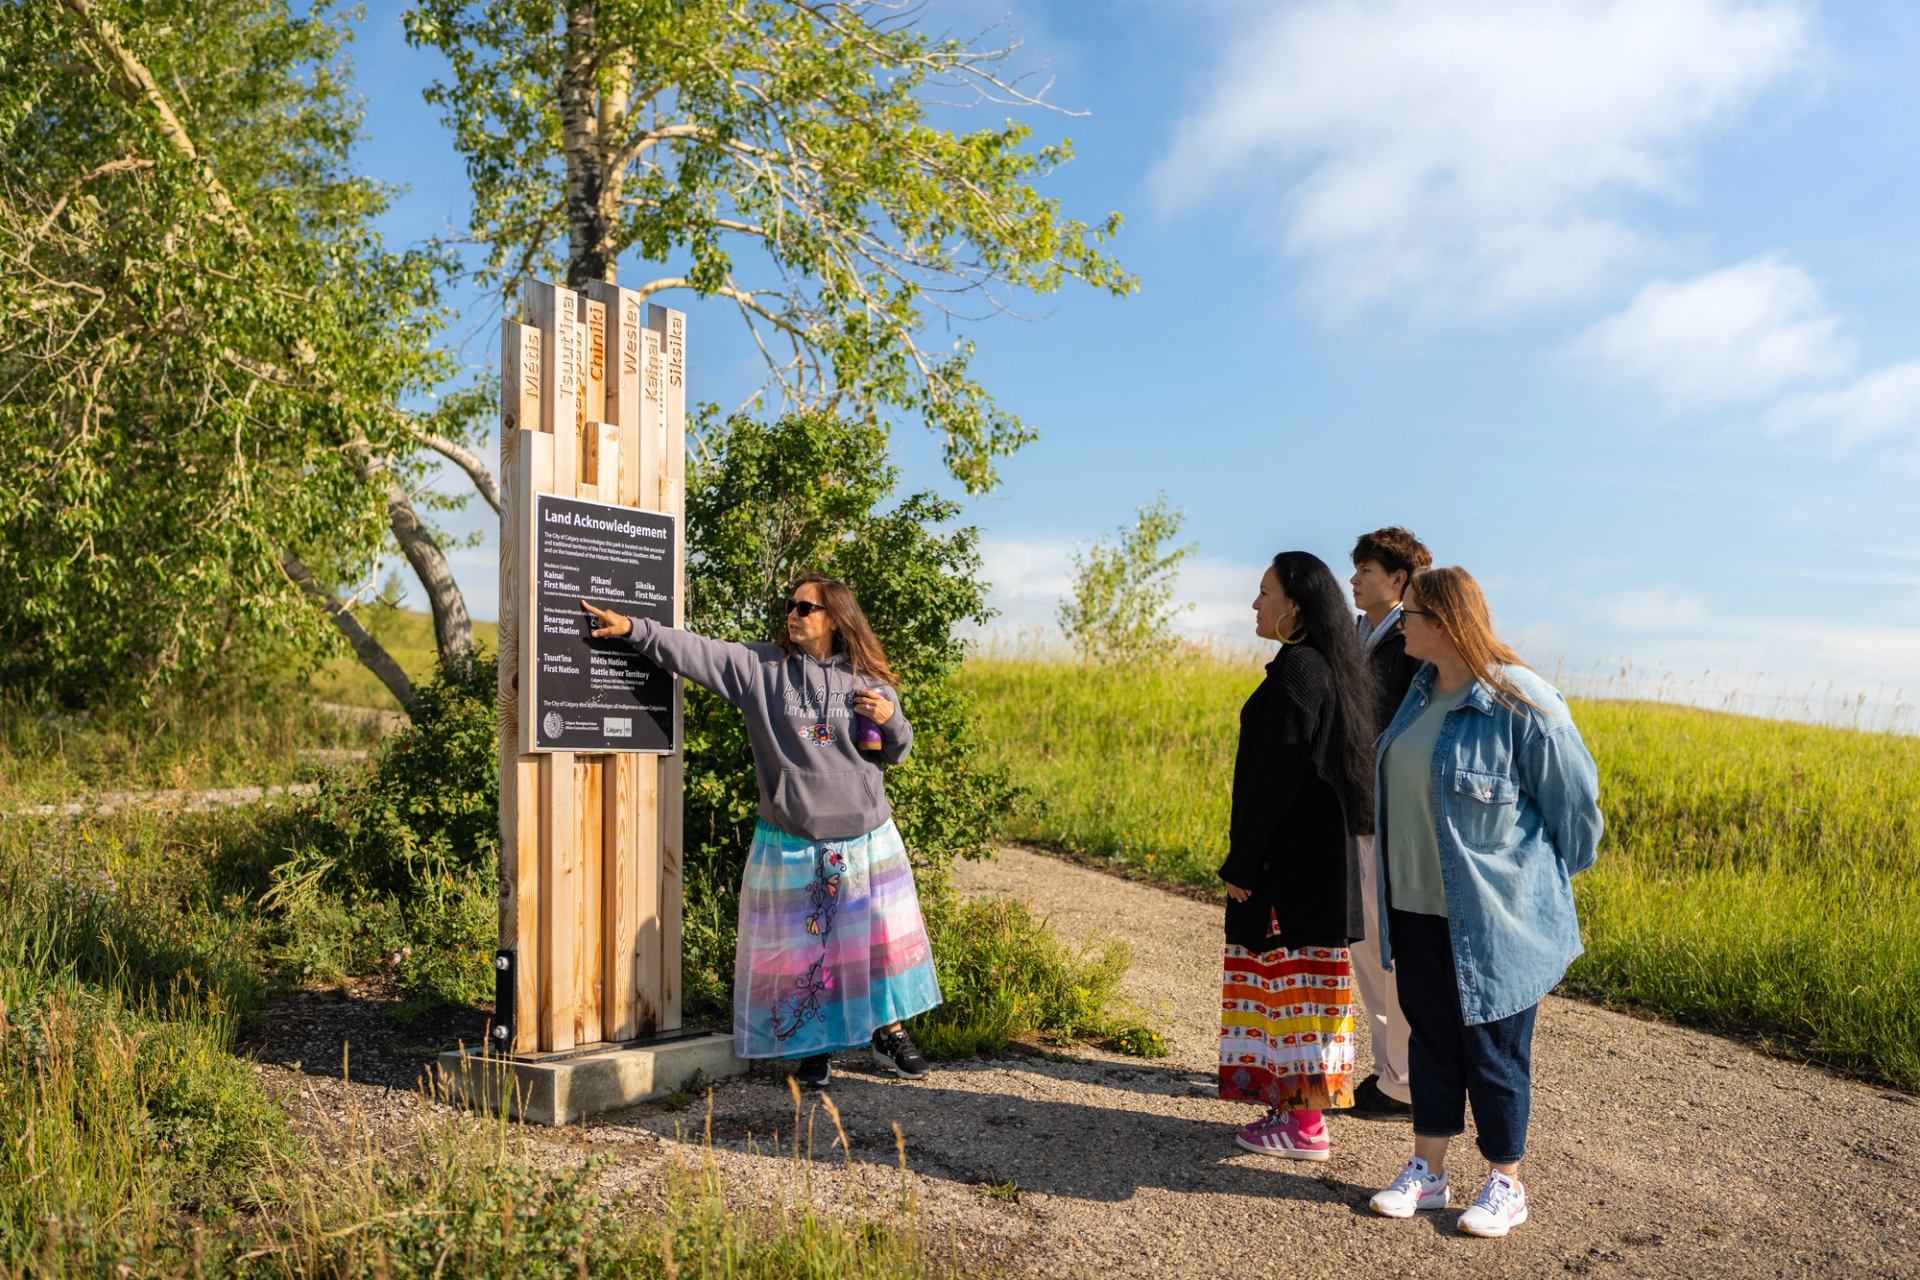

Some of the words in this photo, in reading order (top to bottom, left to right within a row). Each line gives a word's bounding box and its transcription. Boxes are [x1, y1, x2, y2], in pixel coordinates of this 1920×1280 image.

[624, 296, 640, 375] Wesley
[590, 307, 603, 382] Chiniki
[669, 317, 682, 389] Siksika
[524, 334, 539, 400] Métis
[646, 336, 658, 403] Kainai
[545, 508, 571, 525] Land
[574, 514, 667, 540] Acknowledgement
[544, 570, 564, 580] Kainai
[591, 576, 612, 585] Piikani
[544, 580, 558, 589] First
[559, 582, 580, 591] Nation
[635, 581, 655, 591] Siksika
[591, 586, 604, 594] First
[605, 587, 624, 597] Nation
[635, 591, 648, 599] First
[649, 592, 667, 601] Nation
[544, 615, 574, 625] Bearspaw
[544, 625, 558, 633] First
[559, 626, 580, 635] Nation
[590, 657, 607, 665] Métis
[608, 658, 628, 666] Nation
[544, 664, 558, 672] First
[558, 665, 580, 674] Nation
[590, 668, 608, 676] Battle
[609, 669, 624, 677] River
[625, 670, 650, 680] Territory
